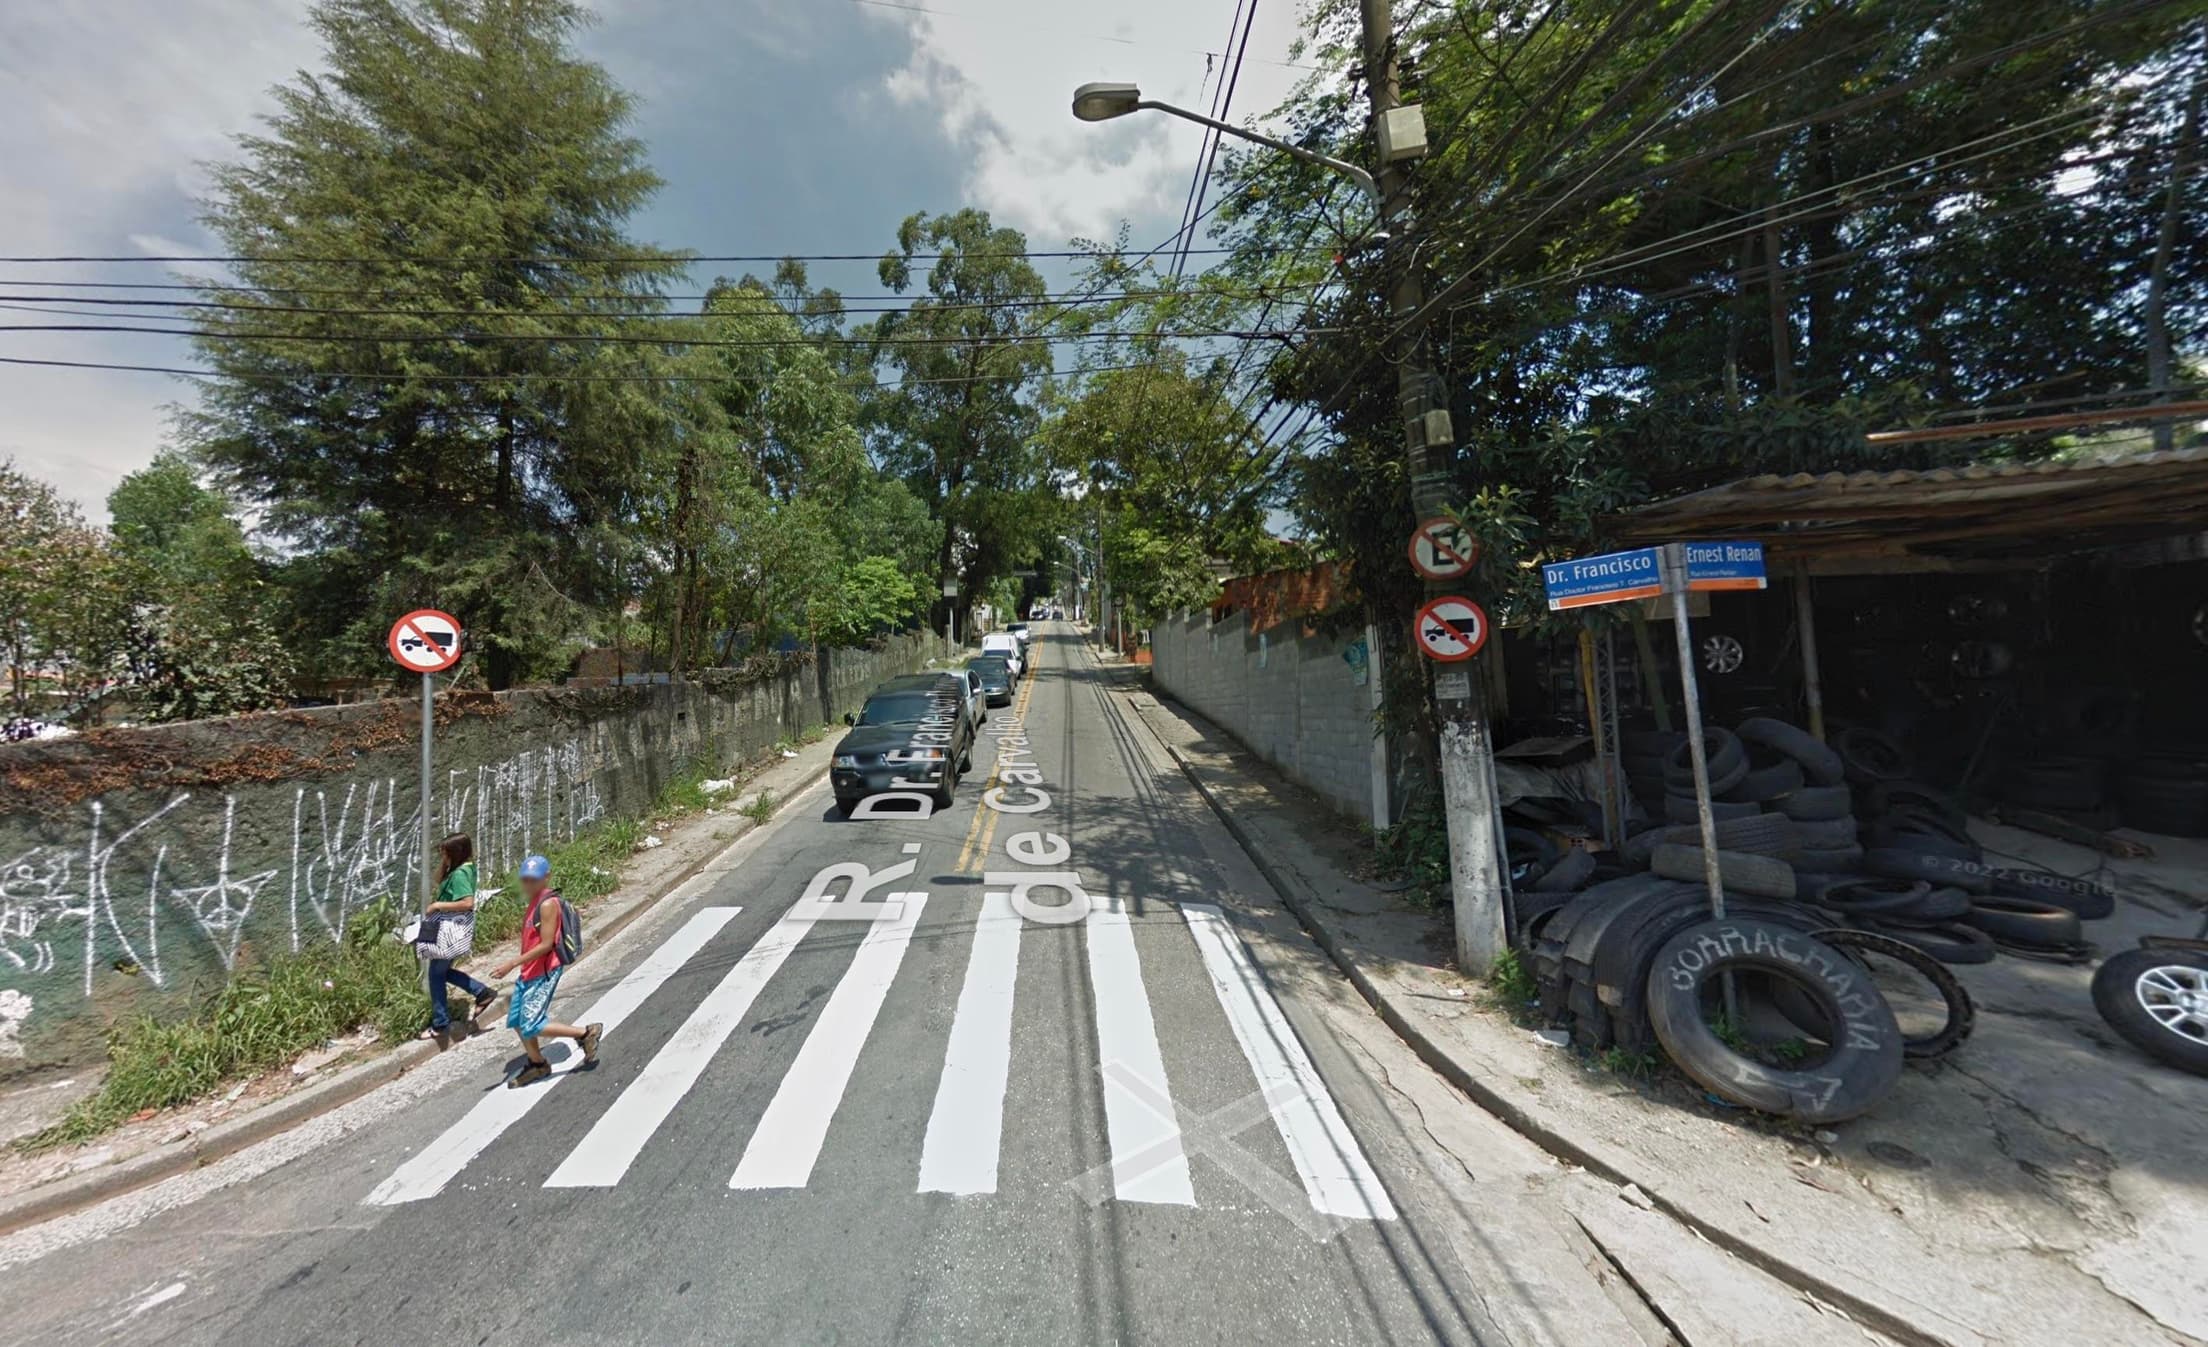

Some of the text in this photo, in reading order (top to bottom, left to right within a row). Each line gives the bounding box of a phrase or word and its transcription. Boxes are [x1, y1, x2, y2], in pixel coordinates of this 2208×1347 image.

[1687, 545, 1762, 563] Ernest Renan
[1547, 555, 1651, 585] Dr. Francisco
[1667, 926, 1881, 1051] BORRACHARIA
